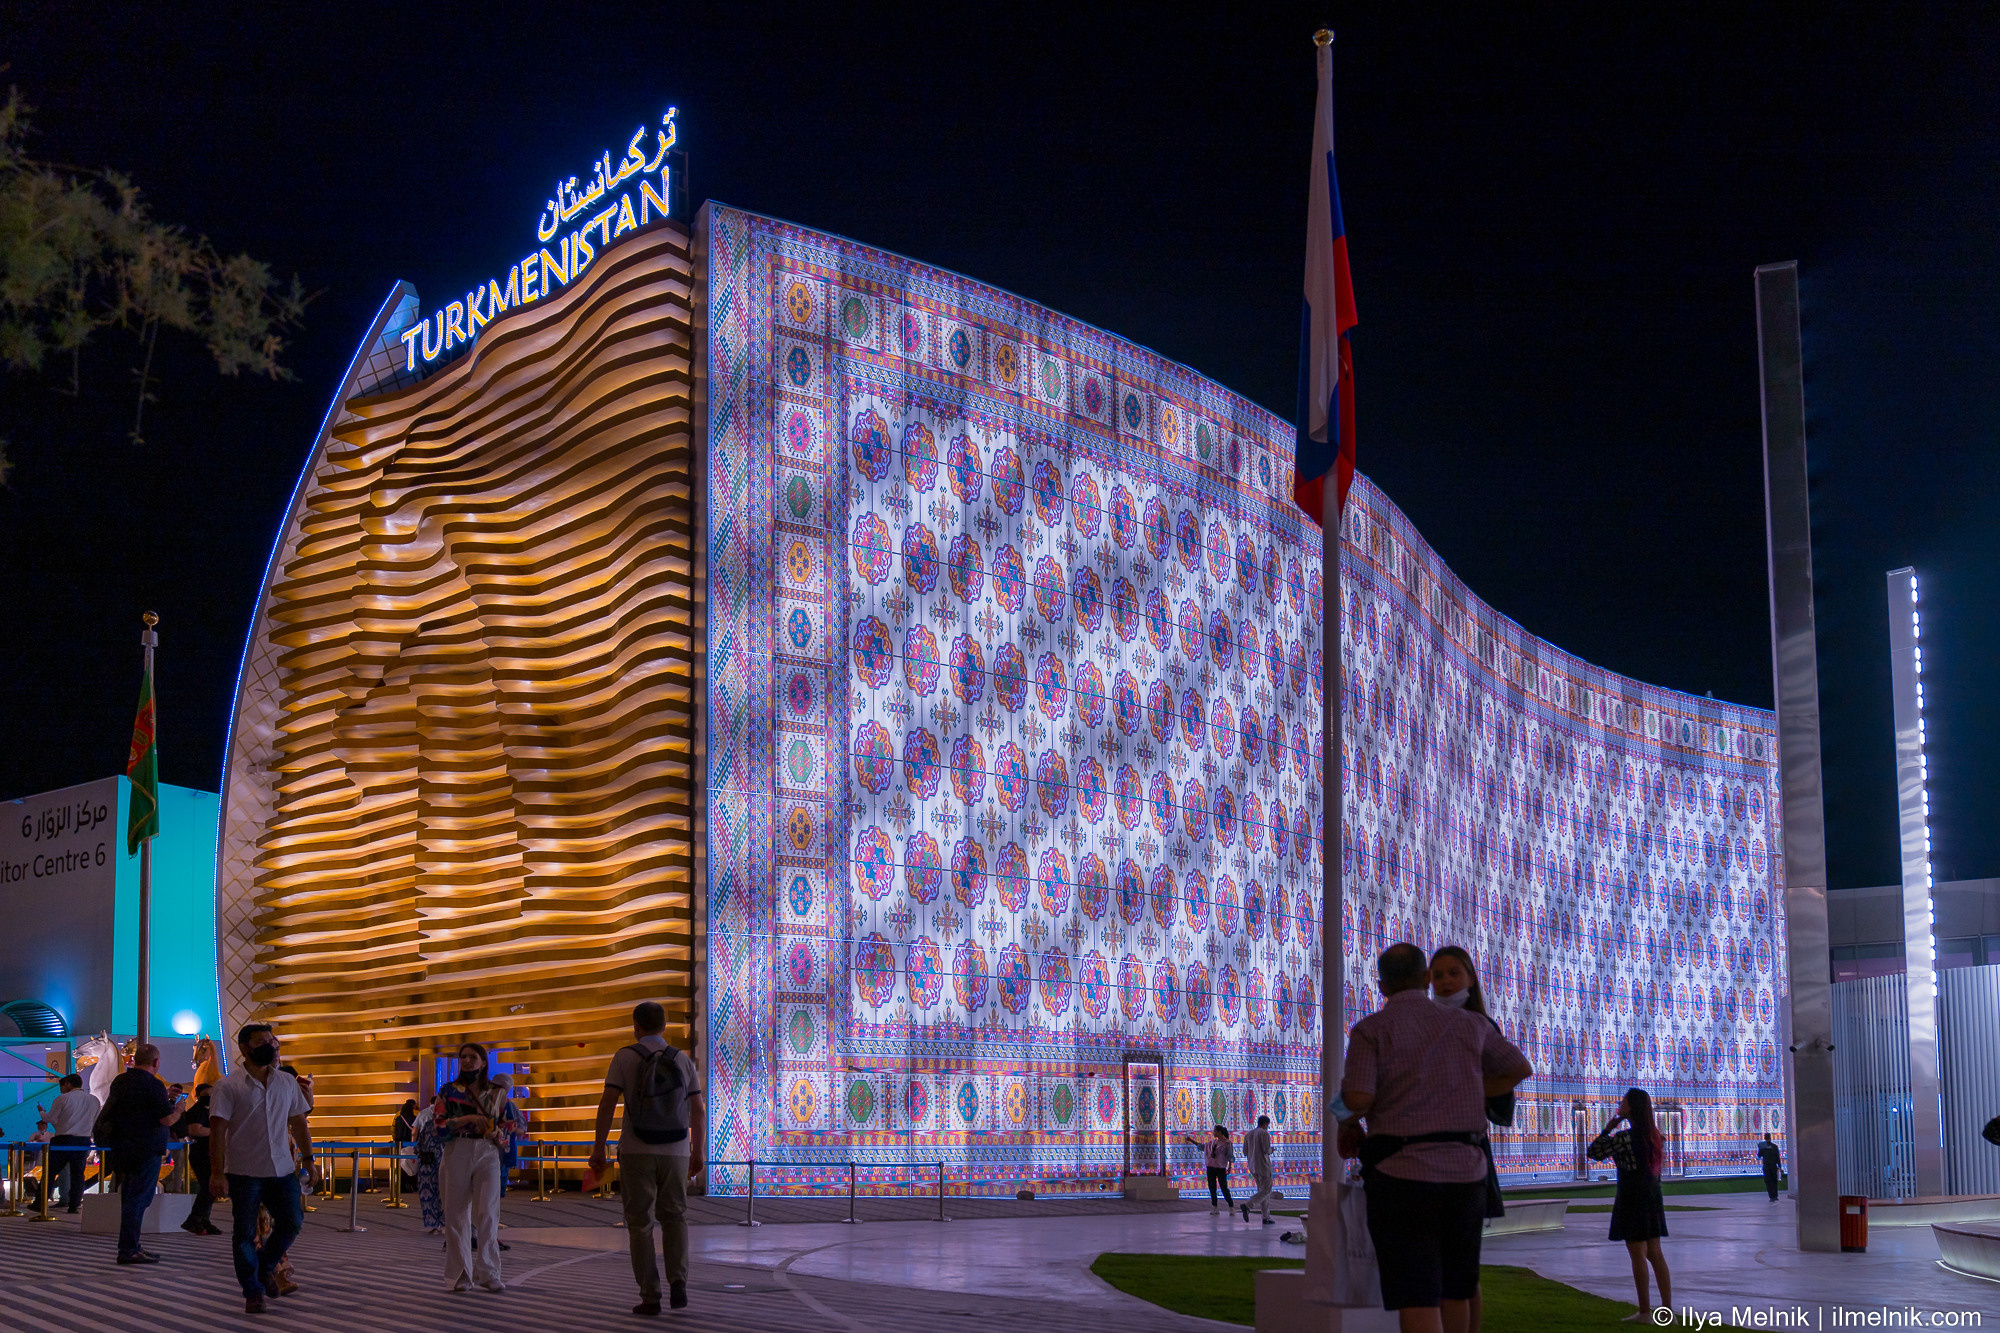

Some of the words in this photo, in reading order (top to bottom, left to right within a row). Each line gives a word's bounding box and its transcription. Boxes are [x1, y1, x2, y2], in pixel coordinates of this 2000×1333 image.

[537, 106, 676, 242] تركمانستان
[400, 165, 671, 371] TURKMENISTAN
[22, 815, 32, 838] 6
[74, 800, 108, 834] مركز
[33, 849, 90, 878] Centre
[95, 842, 106, 867] 6
